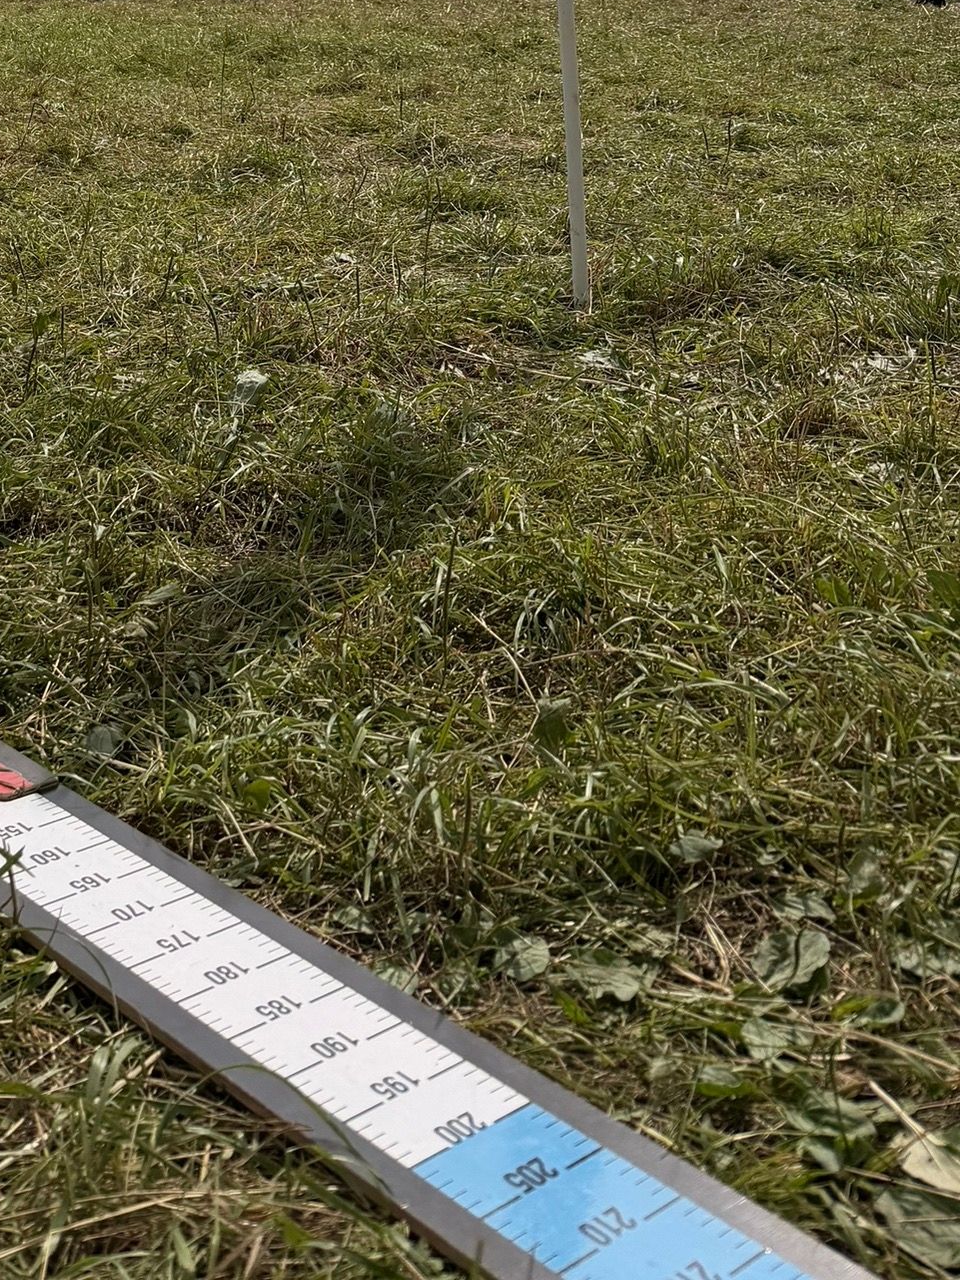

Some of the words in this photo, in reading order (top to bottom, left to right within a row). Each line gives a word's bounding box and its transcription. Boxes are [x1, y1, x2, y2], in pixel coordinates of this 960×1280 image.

[30, 846, 72, 866] 160
[69, 872, 112, 893] 165
[111, 900, 154, 922] 170
[156, 930, 201, 953] 175
[203, 961, 250, 985] 180
[255, 995, 303, 1021] 185
[310, 1031, 359, 1059] 190
[369, 1071, 420, 1100] 195
[433, 1111, 488, 1145] 200
[503, 1156, 560, 1194] 205
[578, 1206, 638, 1246] 210
